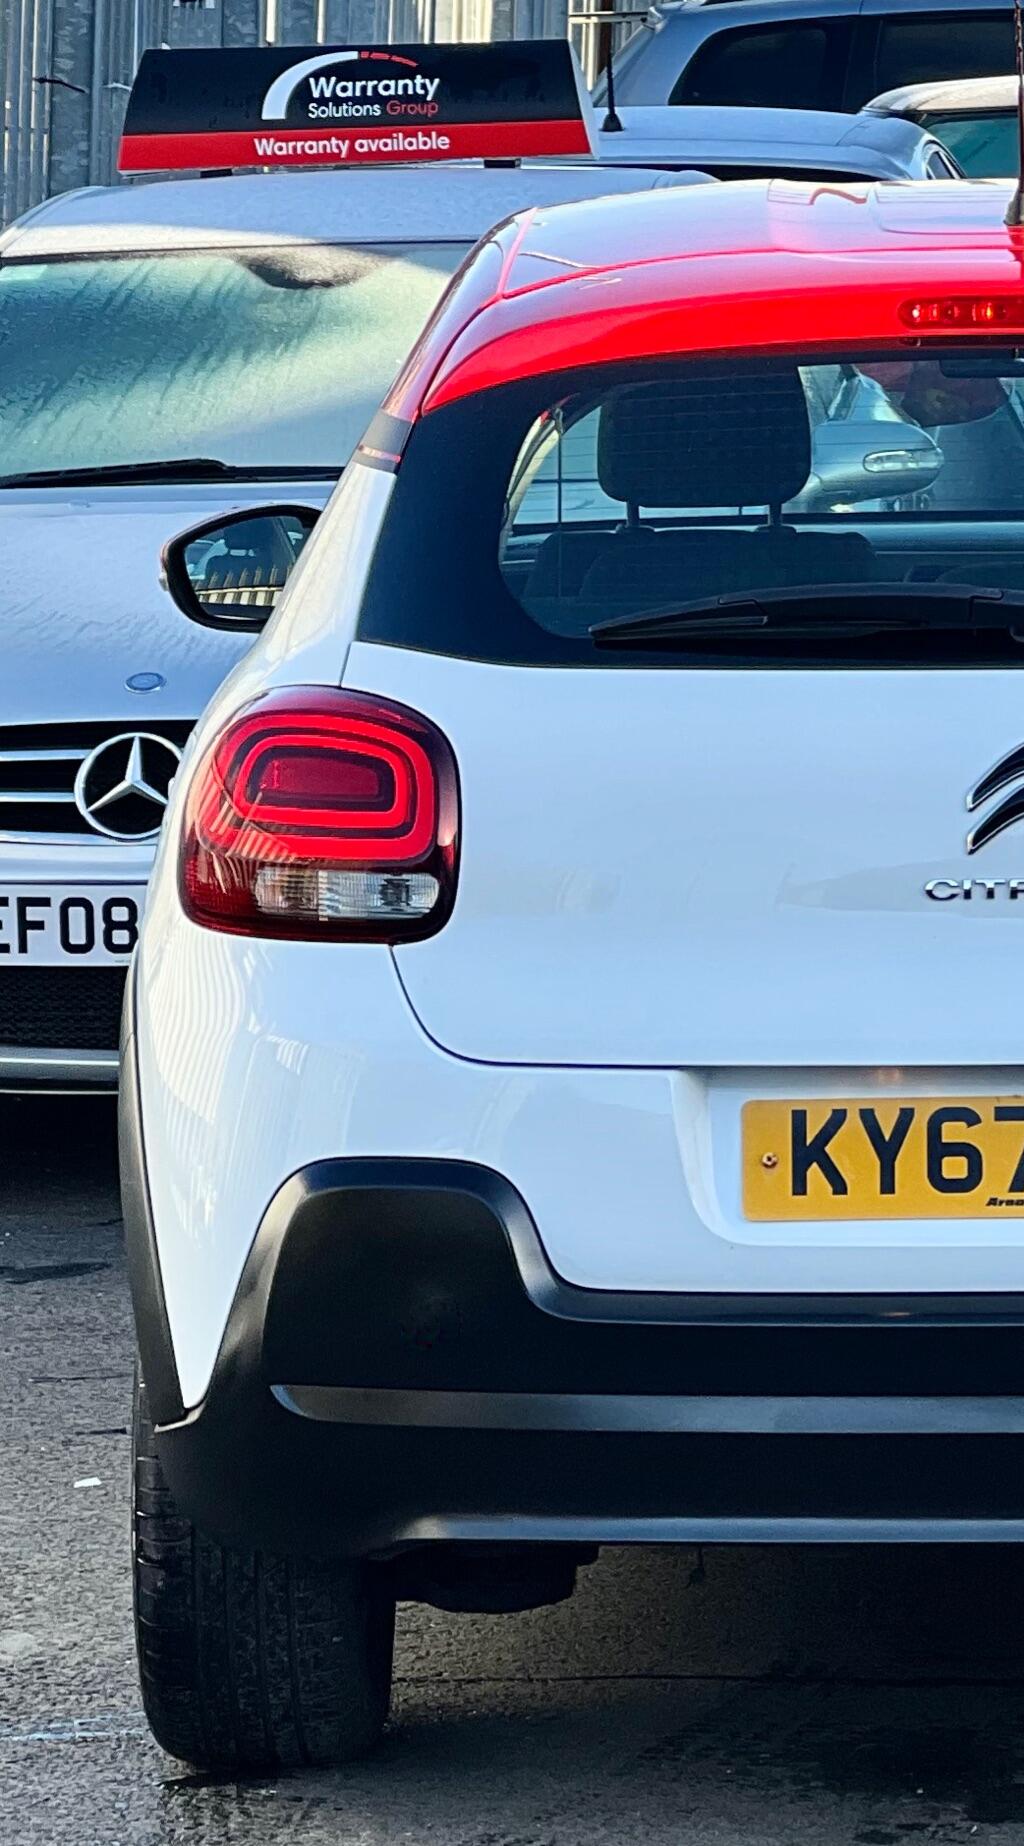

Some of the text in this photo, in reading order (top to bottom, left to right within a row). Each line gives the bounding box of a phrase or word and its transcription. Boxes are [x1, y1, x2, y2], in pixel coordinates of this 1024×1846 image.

[308, 74, 440, 101] Warranty
[308, 100, 439, 118] Solutions Group
[253, 131, 450, 158] Warranty available
